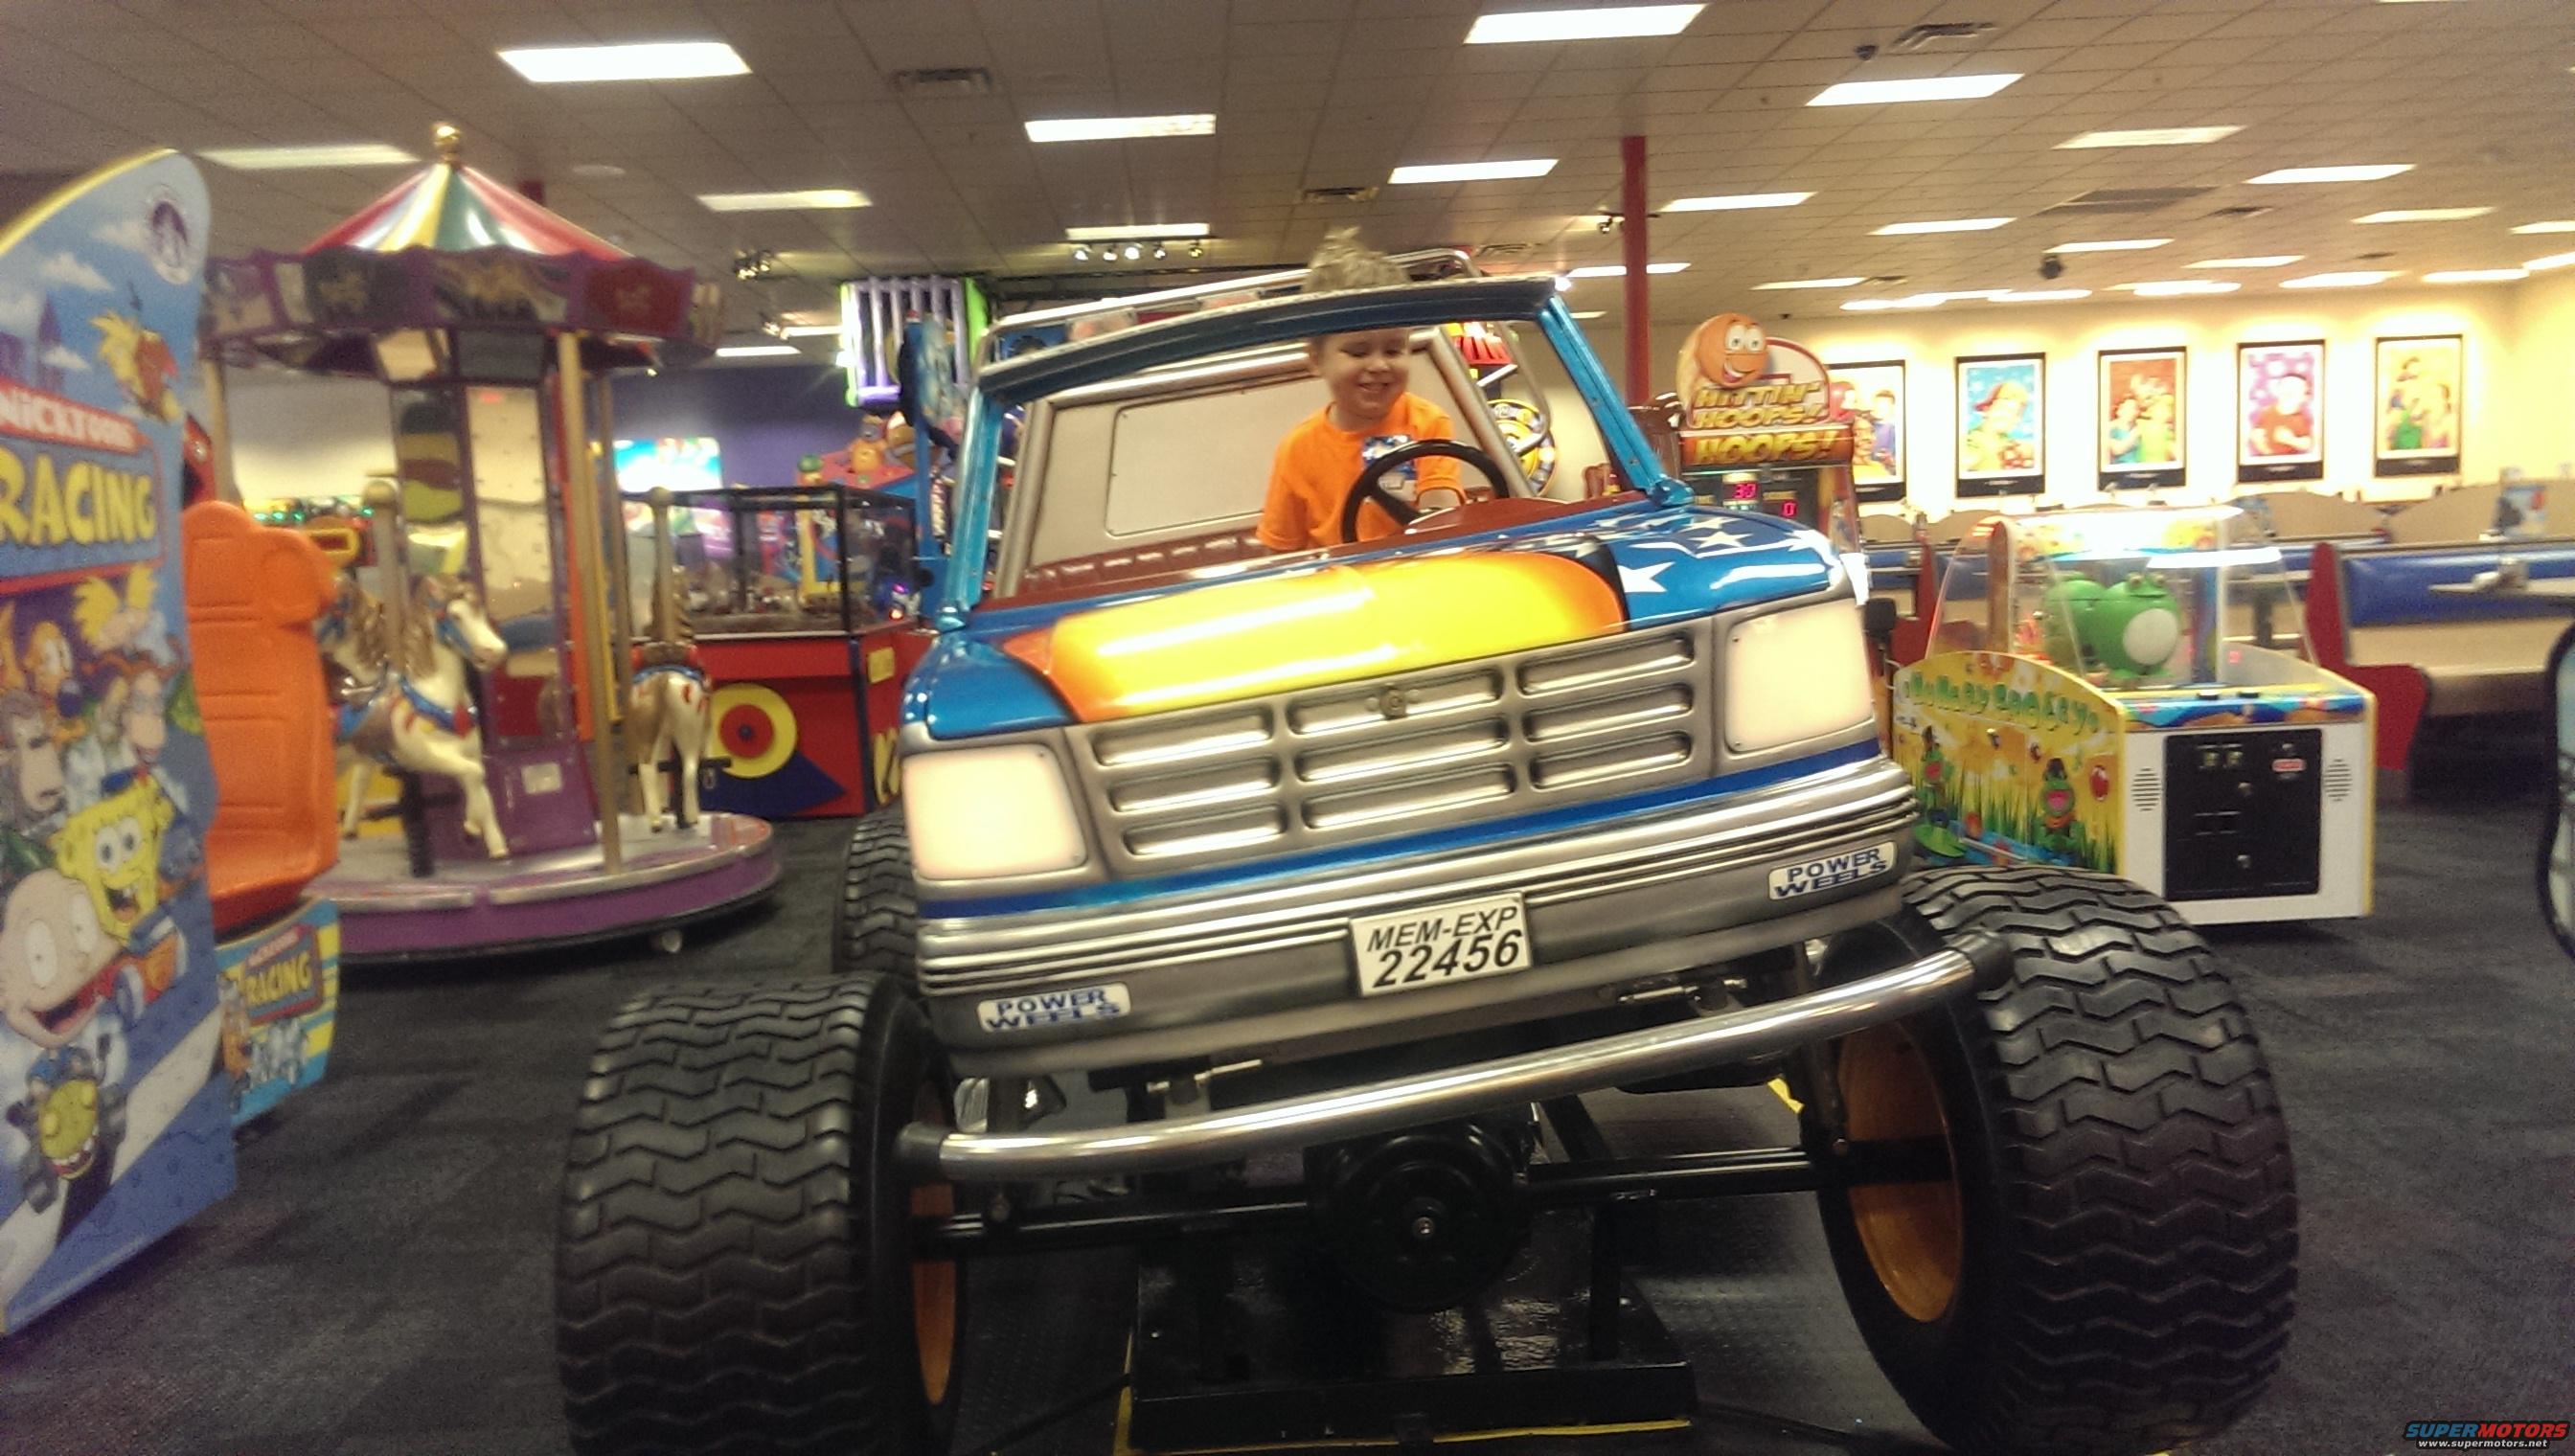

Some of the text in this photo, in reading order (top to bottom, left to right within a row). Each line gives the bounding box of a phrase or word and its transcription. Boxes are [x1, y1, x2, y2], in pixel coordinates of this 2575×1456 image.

[1694, 430, 1839, 466] HOOPS!
[0, 444, 157, 547] RACING
[1787, 848, 1880, 882] POWER
[1367, 906, 1517, 952] MEM-EXP
[1373, 929, 1522, 989] 22456
[997, 990, 1105, 1015] POWER
